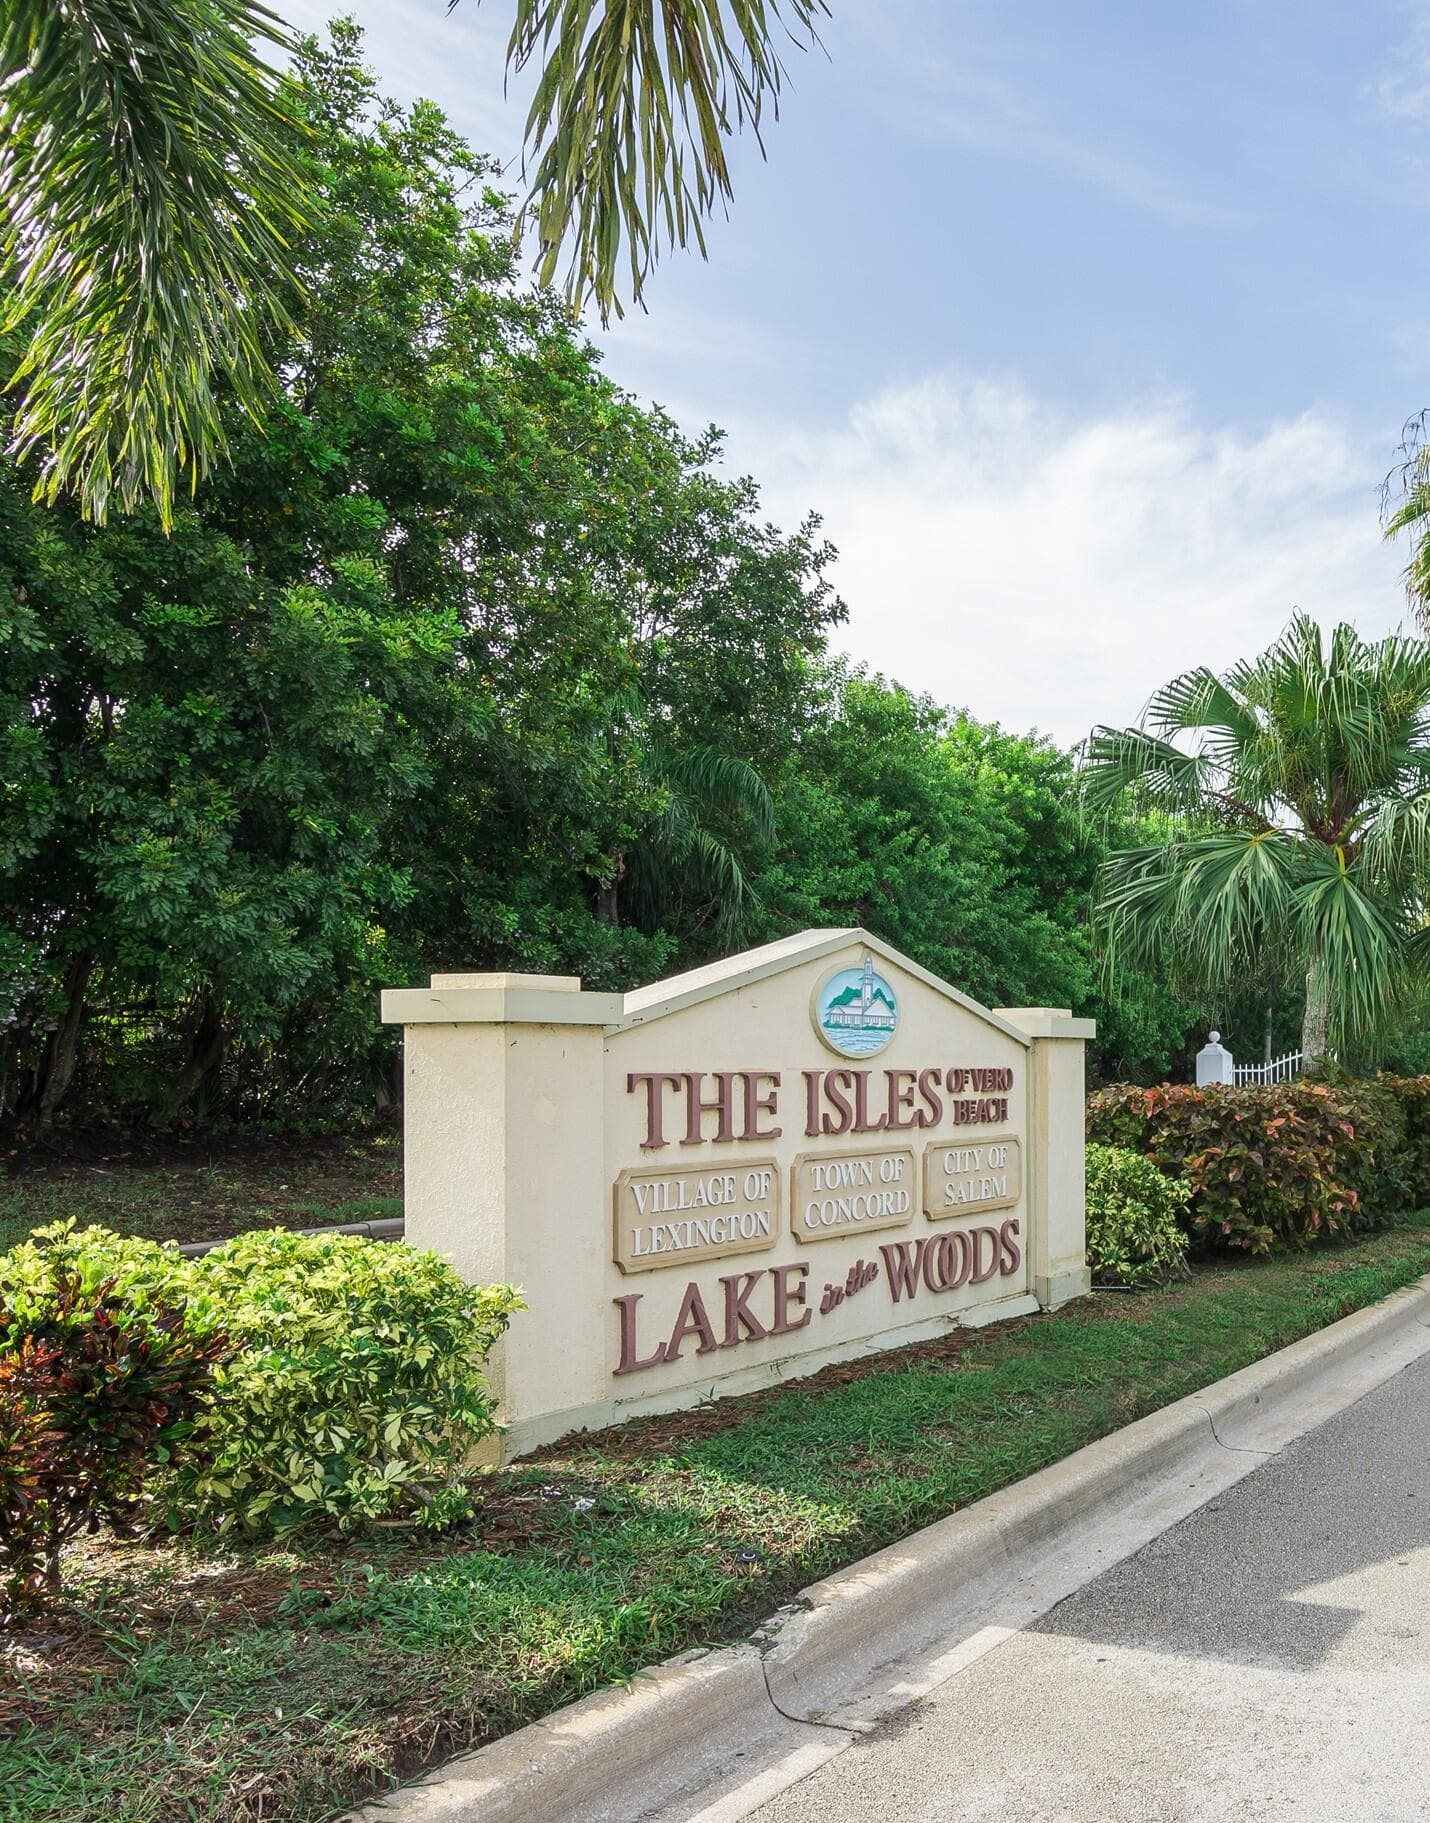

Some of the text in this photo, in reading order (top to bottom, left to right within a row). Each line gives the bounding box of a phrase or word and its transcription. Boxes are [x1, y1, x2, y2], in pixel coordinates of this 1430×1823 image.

[946, 1067, 1014, 1093] OF VERO
[626, 1068, 943, 1148] THE ISLES
[953, 1098, 1009, 1125] BEACH
[811, 1157, 905, 1192] TOWN OF
[943, 1147, 1008, 1175] CITY OF
[631, 1171, 772, 1215] VILLAGE OF
[804, 1190, 910, 1228] CONCORD
[943, 1176, 1008, 1207] SALEM
[631, 1210, 770, 1257] LEXINGTON
[612, 1218, 1021, 1376] LAKE in the WOODS
